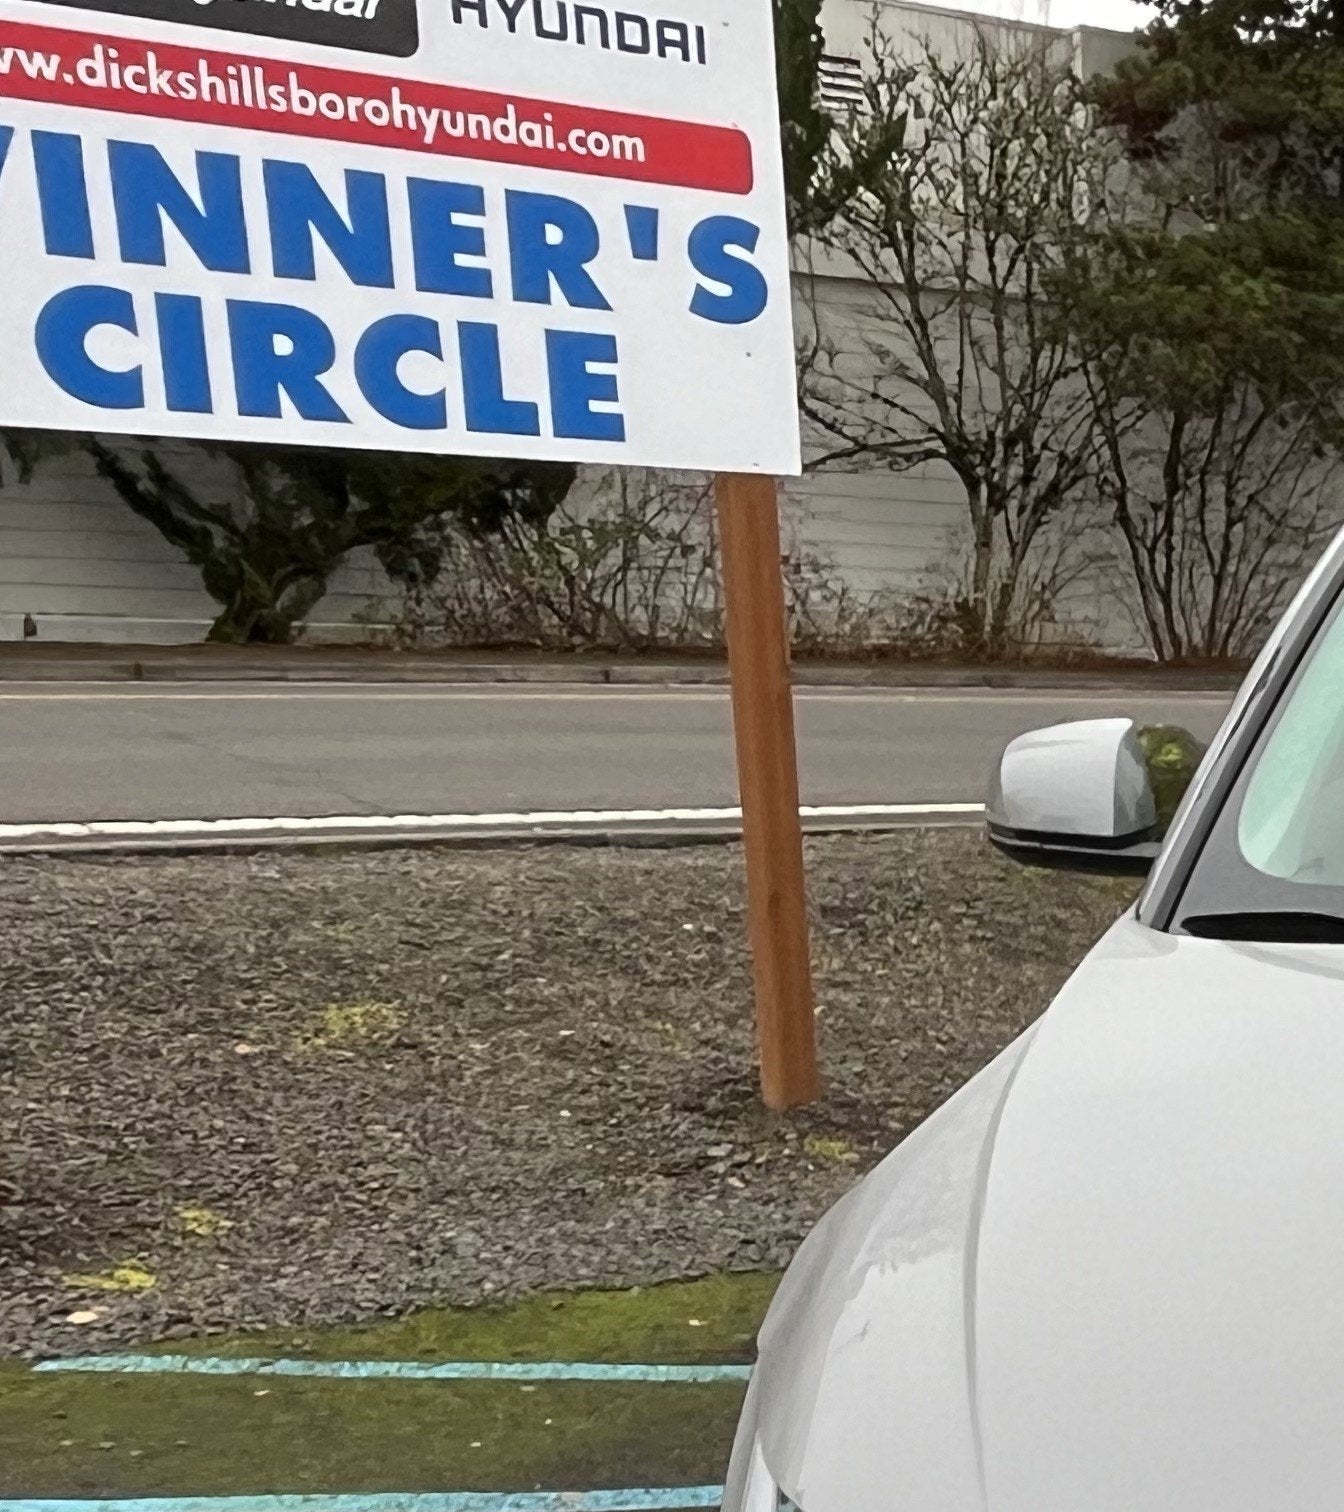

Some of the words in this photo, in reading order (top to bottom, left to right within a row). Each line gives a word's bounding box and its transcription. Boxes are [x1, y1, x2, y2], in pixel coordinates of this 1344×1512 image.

[451, 0, 707, 65] HYUNDAI
[0, 126, 769, 325] INNER'S
[35, 285, 626, 443] CIRCLE
